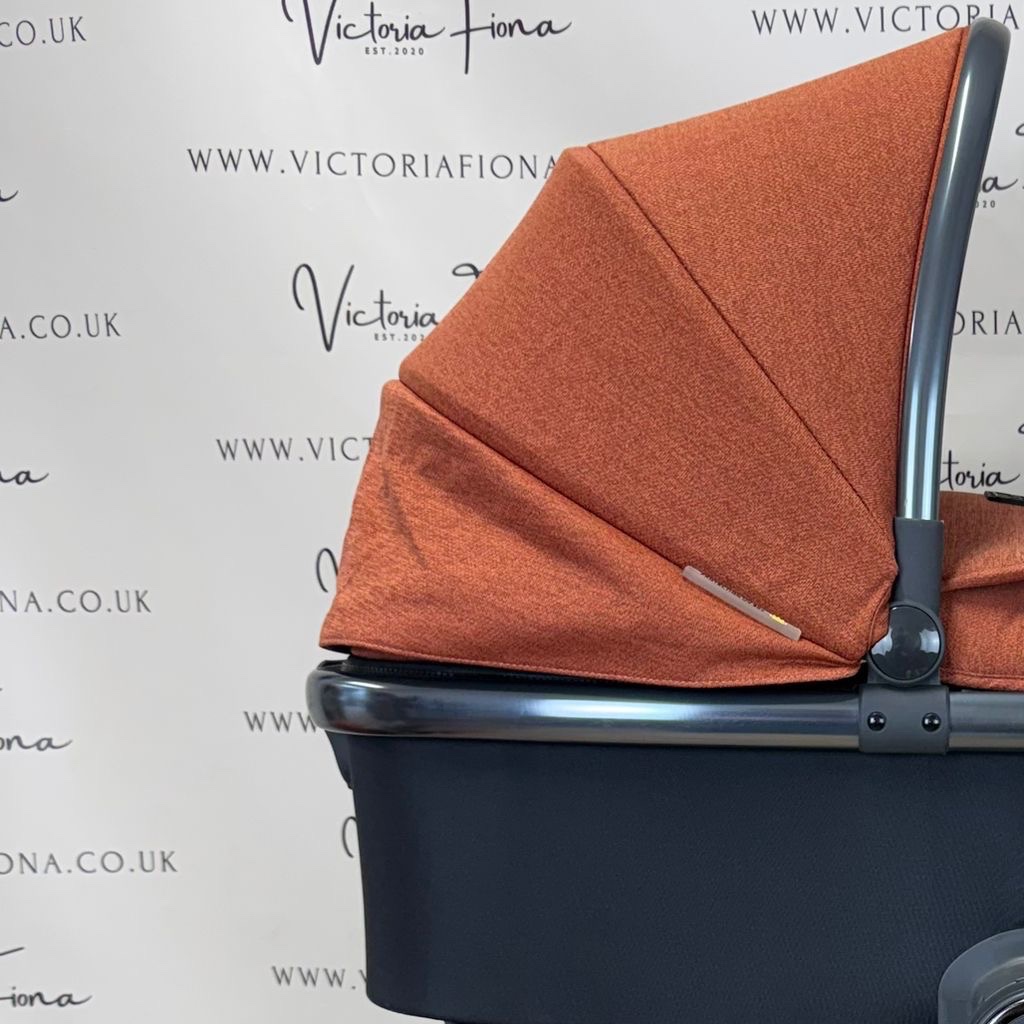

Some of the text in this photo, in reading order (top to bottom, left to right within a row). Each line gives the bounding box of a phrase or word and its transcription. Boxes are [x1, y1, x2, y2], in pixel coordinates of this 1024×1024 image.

[281, 0, 572, 75] Victoria Fiona
[365, 46, 425, 56] EST.2020
[292, 263, 441, 353] Victoria
[374, 333, 426, 341] EST.202
[940, 449, 1021, 491] toria
